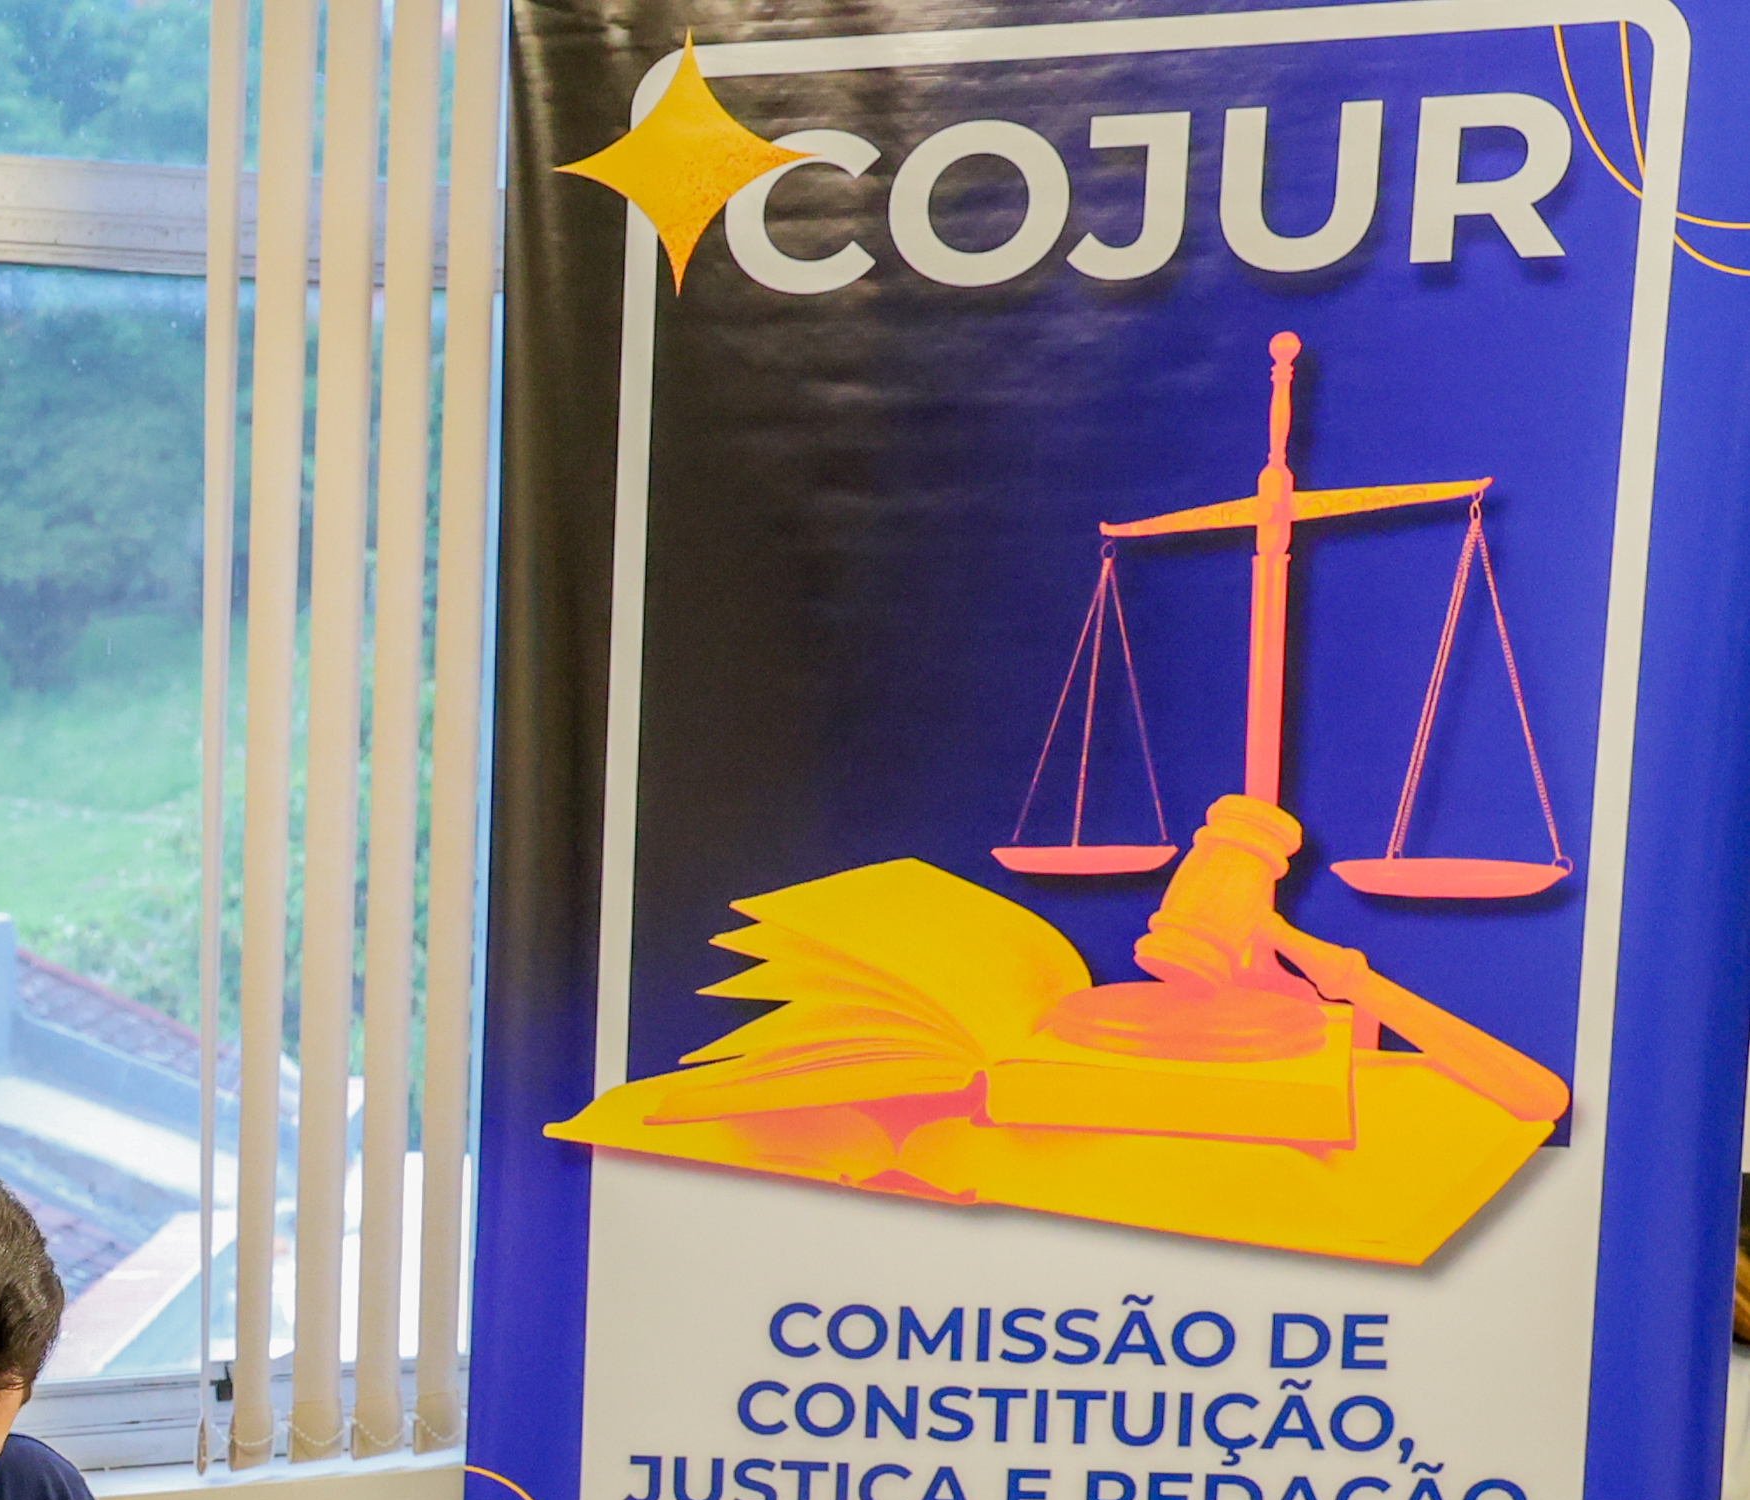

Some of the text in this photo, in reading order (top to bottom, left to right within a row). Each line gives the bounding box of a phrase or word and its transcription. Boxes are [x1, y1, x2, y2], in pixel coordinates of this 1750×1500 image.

[725, 92, 1572, 295] COJUR
[769, 1293, 1390, 1370] COMISSÃO DE
[737, 1378, 1416, 1467] CONSTITUIÇÃO,
